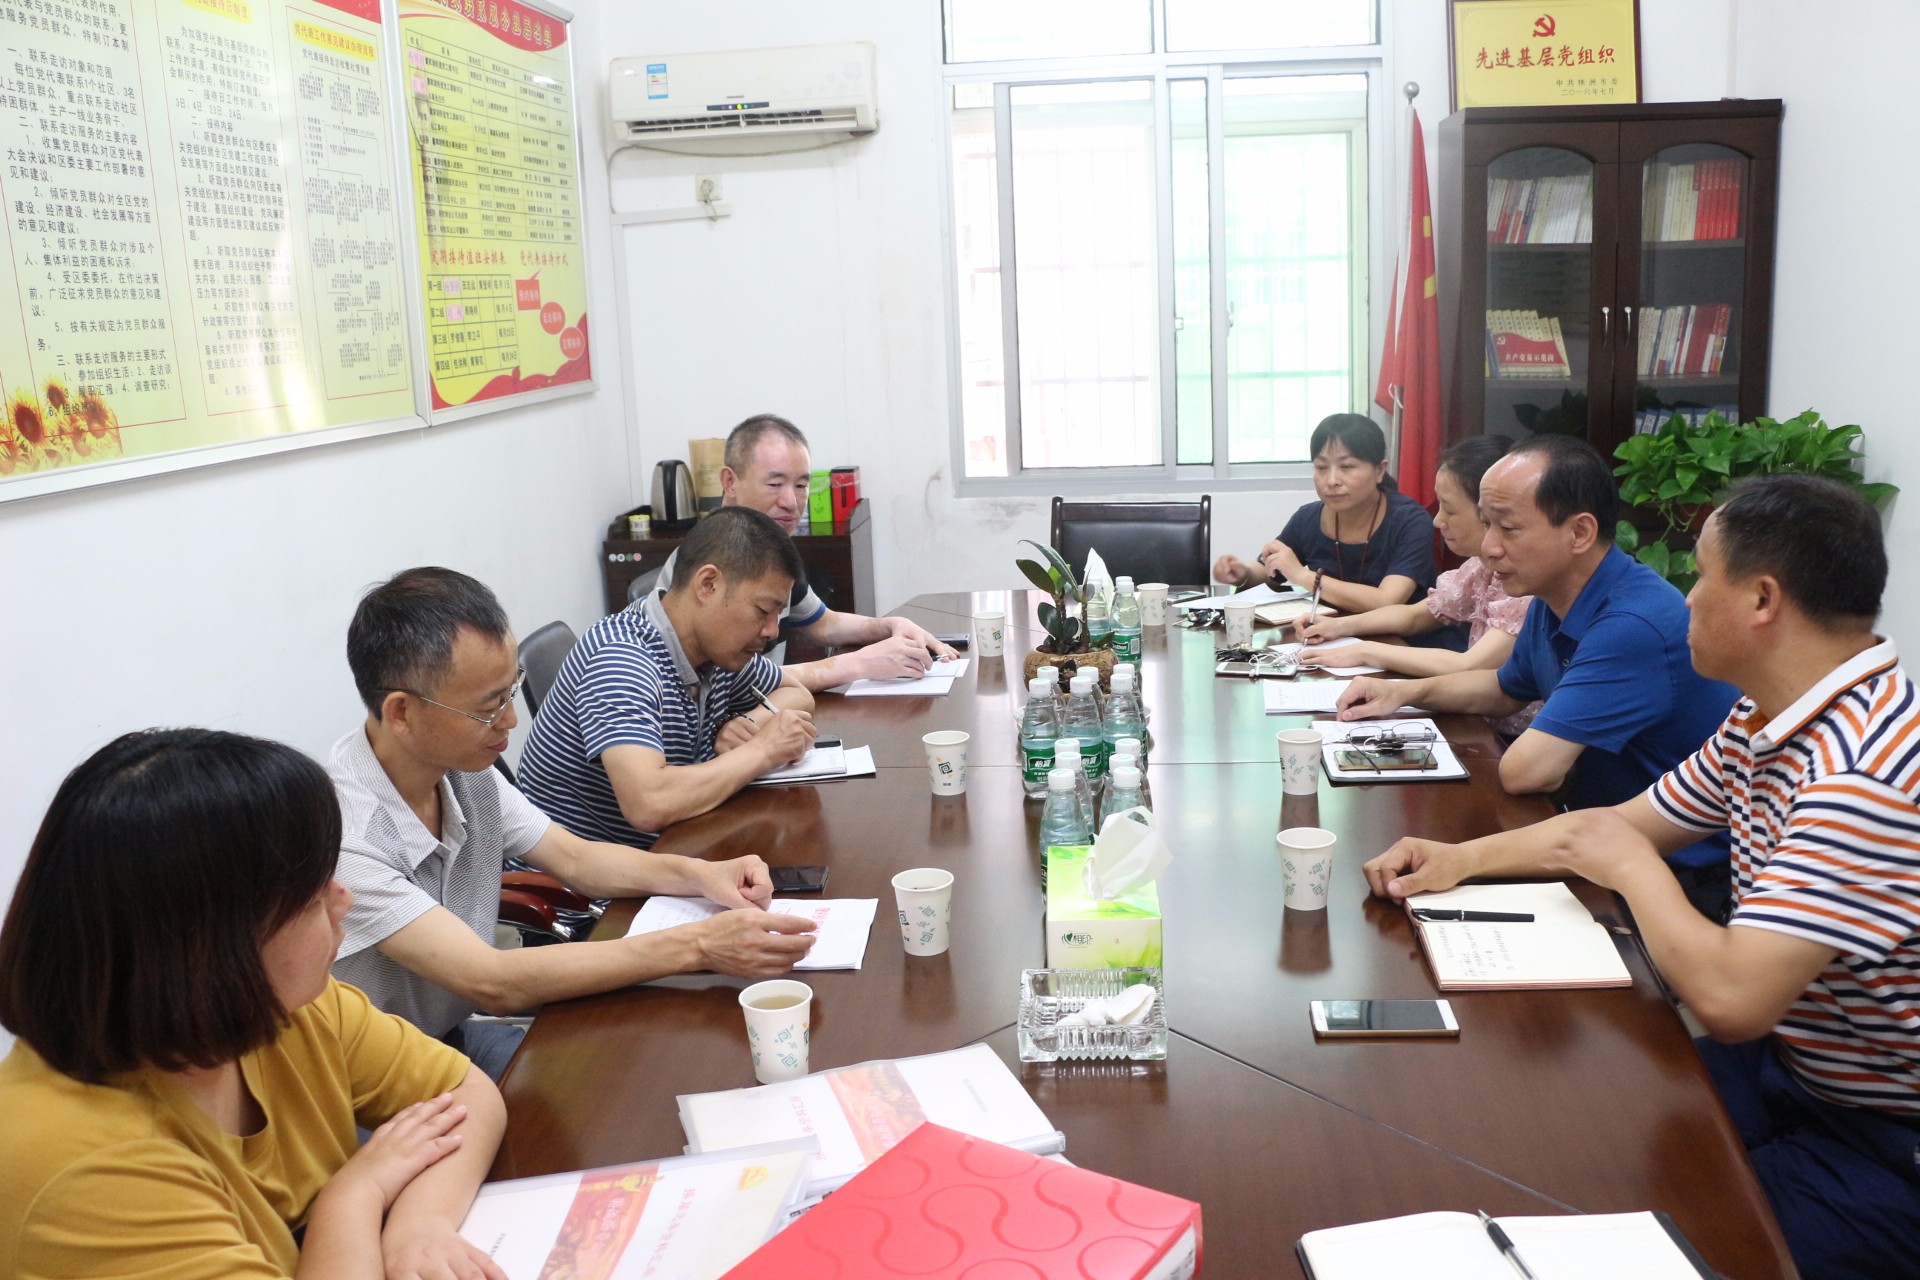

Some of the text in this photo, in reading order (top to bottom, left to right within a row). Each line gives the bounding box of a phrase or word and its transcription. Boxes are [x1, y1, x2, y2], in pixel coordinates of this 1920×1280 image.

[3, 0, 127, 36] 表与党员群众的联系，更
[1475, 44, 1616, 70] 先进基层党组织
